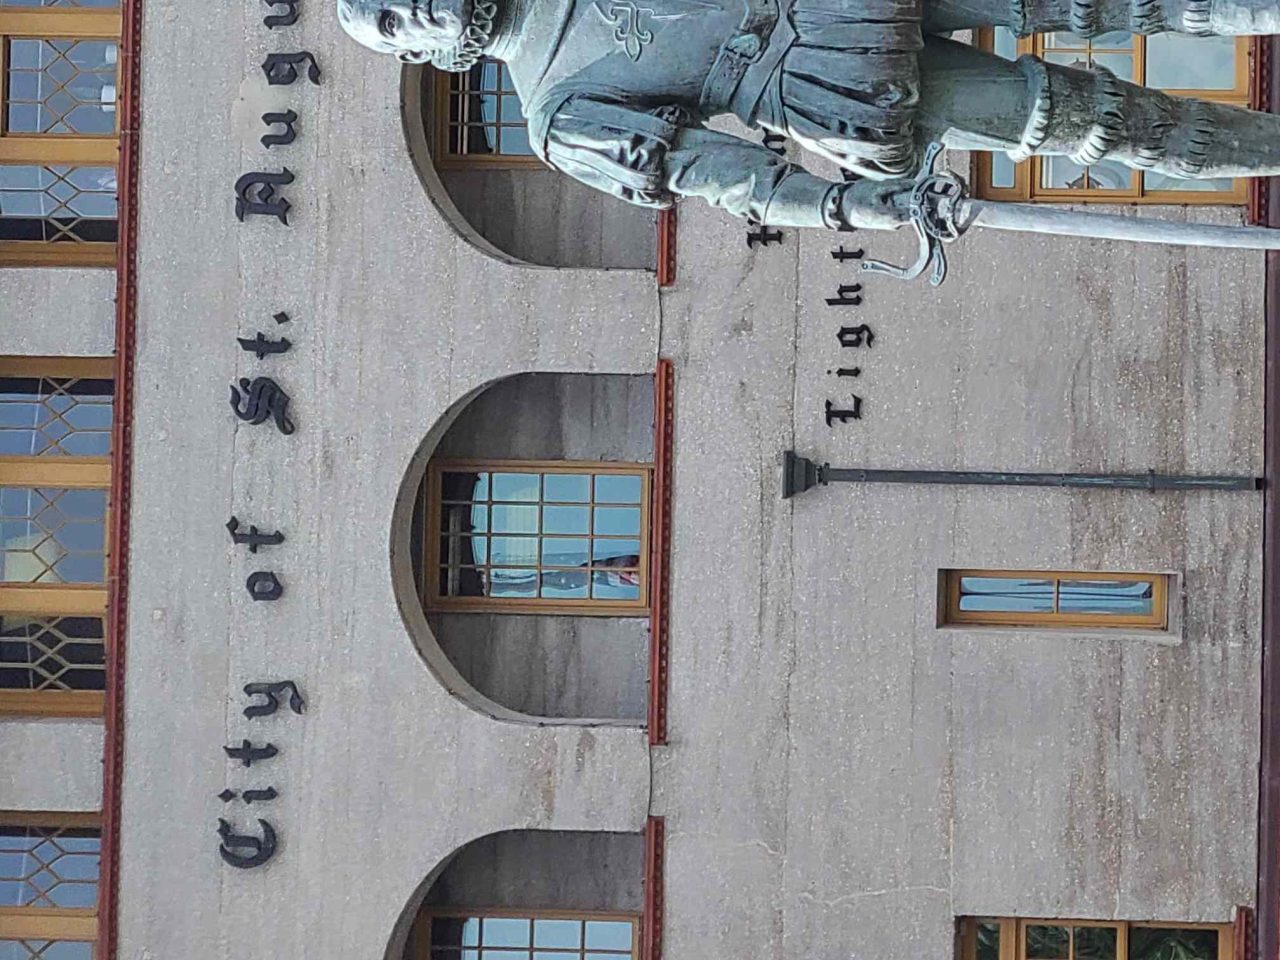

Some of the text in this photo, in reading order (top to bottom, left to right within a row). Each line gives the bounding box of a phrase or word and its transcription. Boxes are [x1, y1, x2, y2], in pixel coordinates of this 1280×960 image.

[231, 312, 295, 435] St.
[226, 516, 285, 600] of
[218, 681, 305, 869] City
